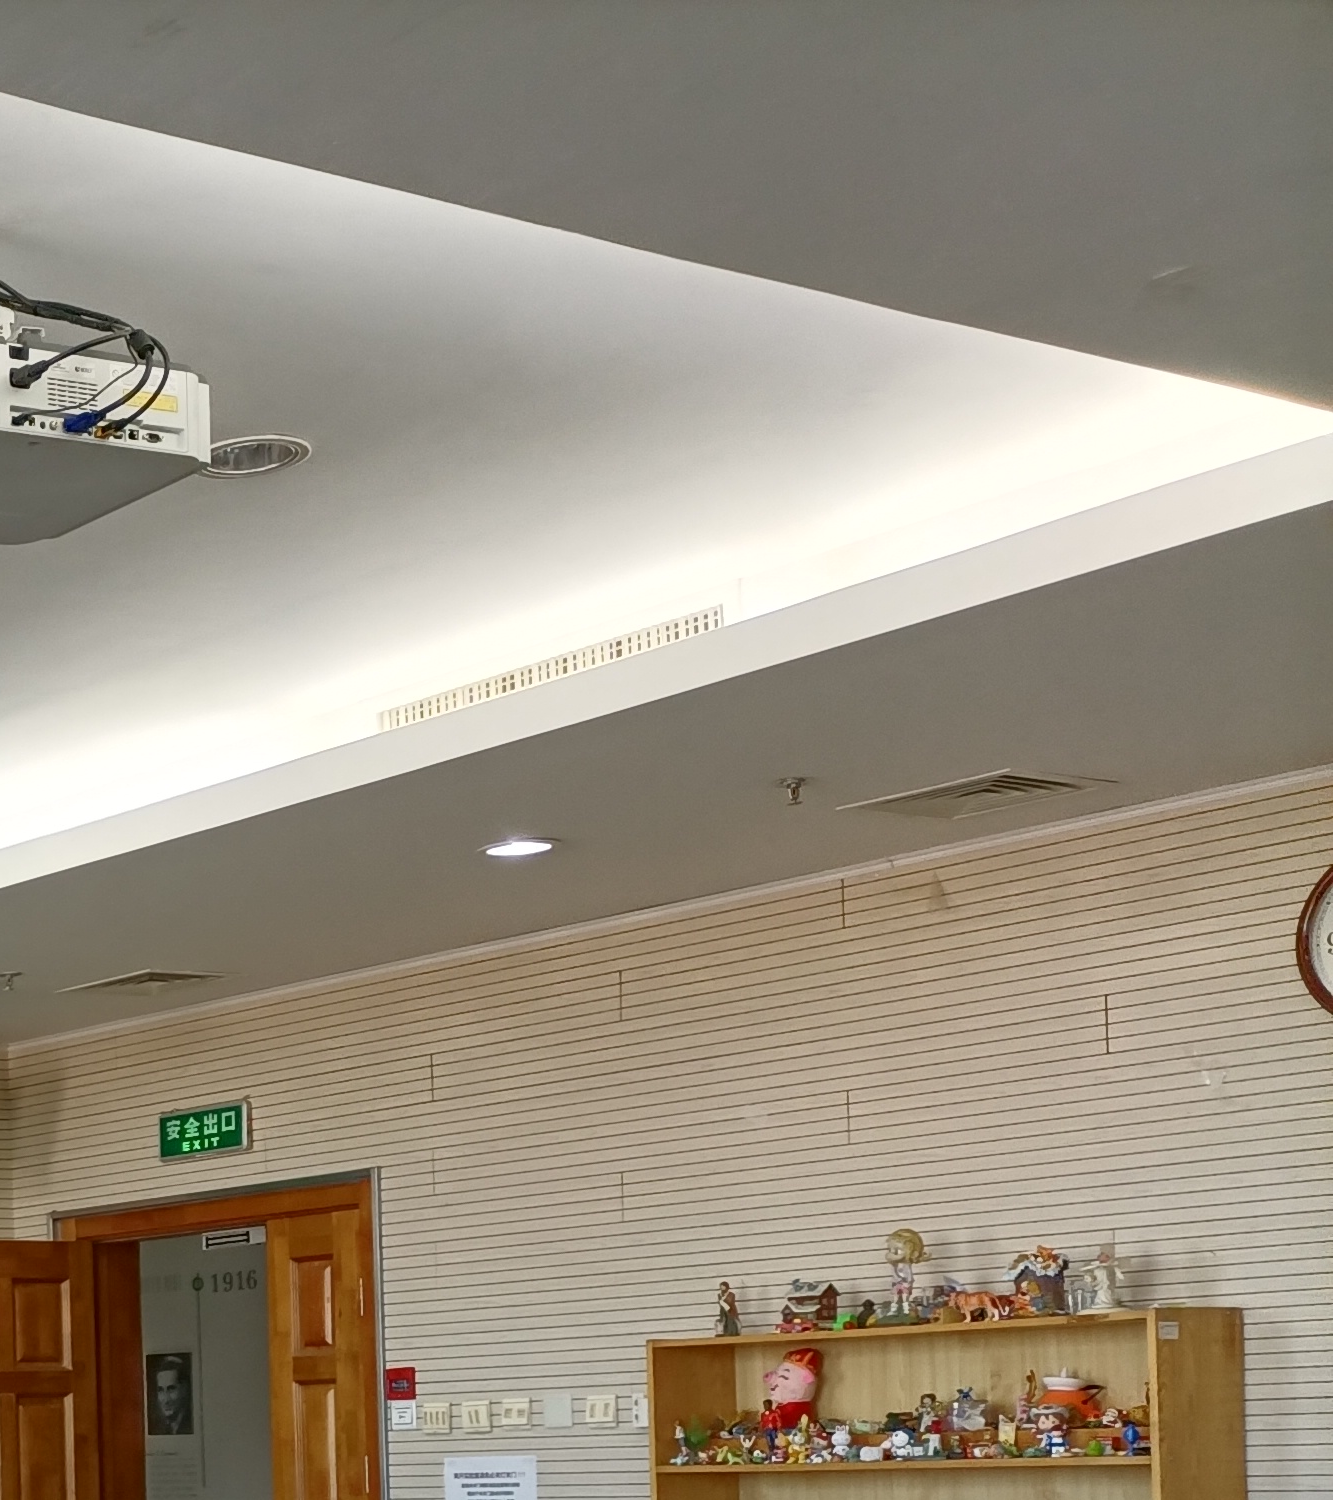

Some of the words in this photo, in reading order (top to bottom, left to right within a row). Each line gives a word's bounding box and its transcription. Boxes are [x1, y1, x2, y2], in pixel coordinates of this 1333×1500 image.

[166, 1111, 235, 1141] 安全出口
[182, 1137, 220, 1152] EXIT
[211, 1269, 258, 1293] 1916
